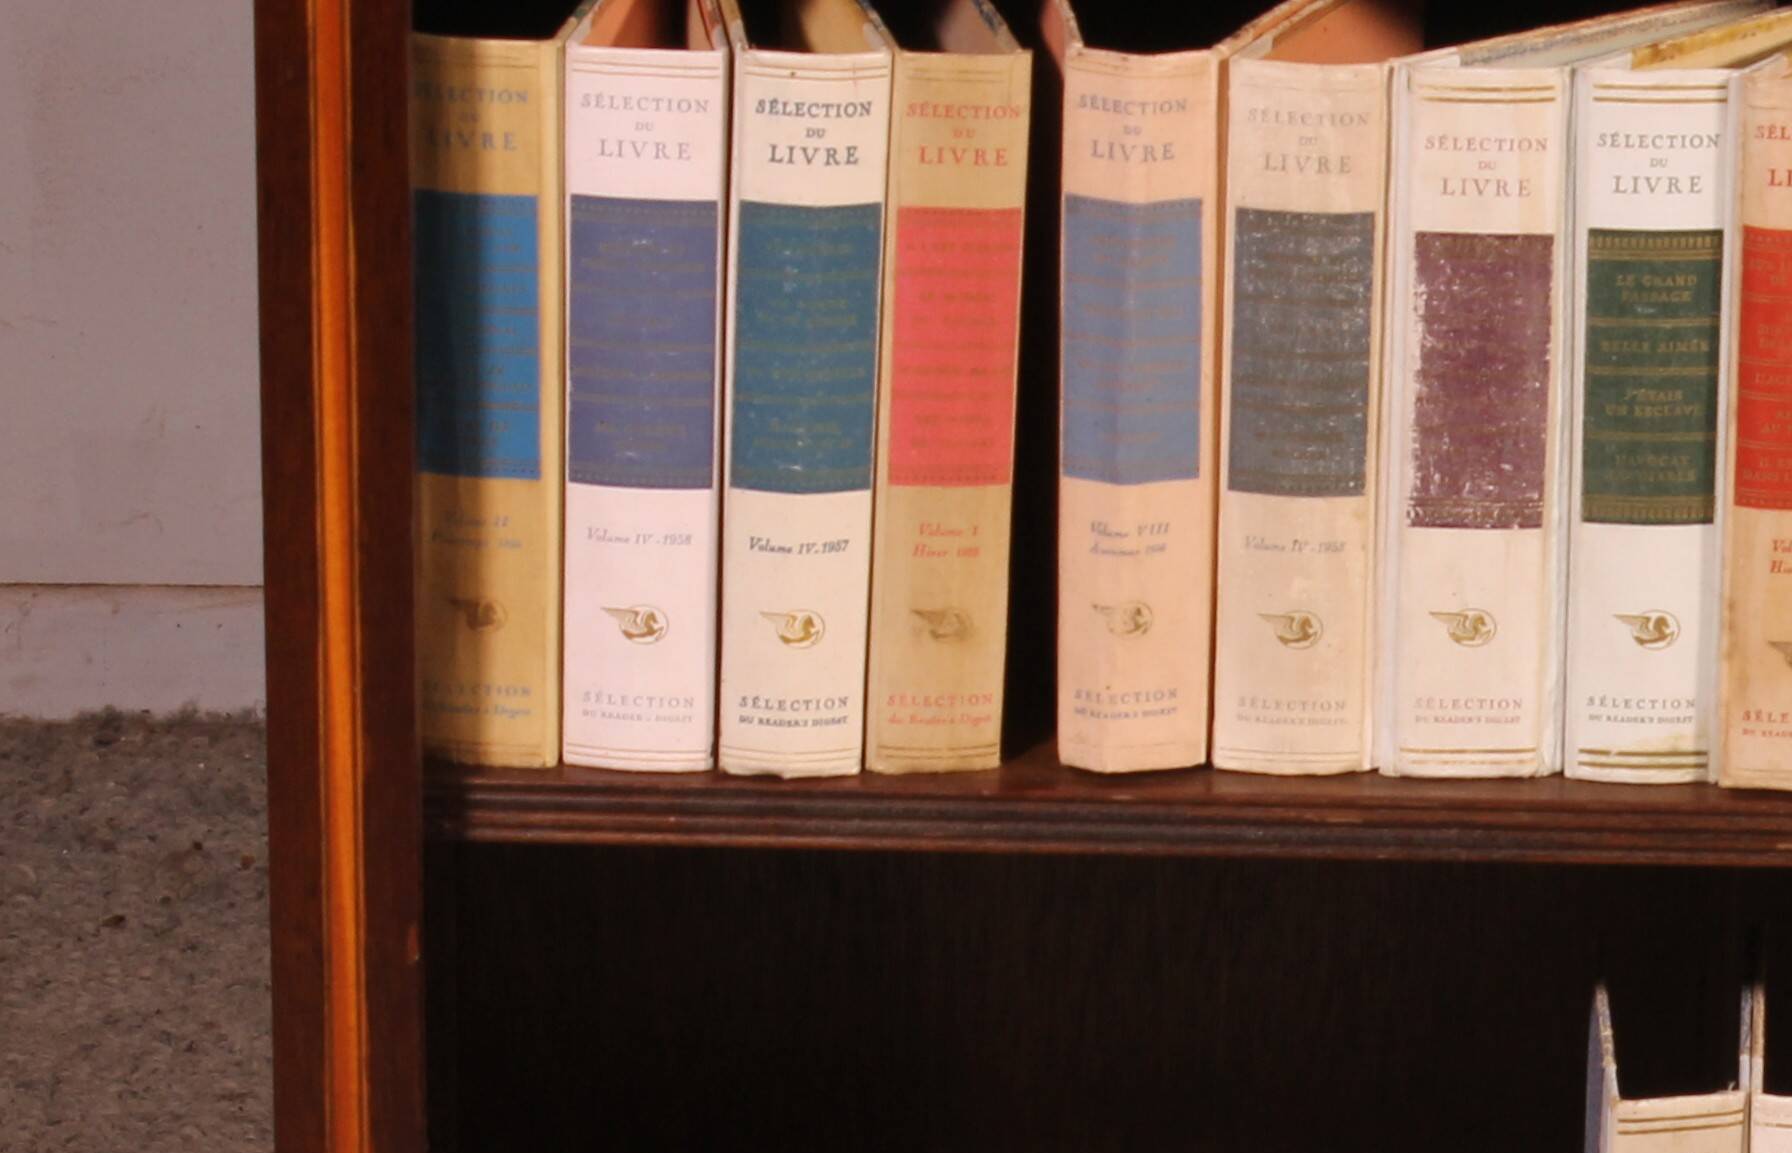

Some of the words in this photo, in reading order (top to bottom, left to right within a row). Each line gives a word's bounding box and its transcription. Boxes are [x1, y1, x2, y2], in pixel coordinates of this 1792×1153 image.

[635, 121, 654, 132] DU
[805, 127, 826, 139] DU
[954, 128, 976, 139] DU
[599, 137, 693, 162] LIVRE
[1298, 136, 1317, 146] DU
[768, 144, 860, 167] LIVRE
[918, 146, 1009, 168] LIVRE
[1090, 140, 1176, 163] LIVRE
[1264, 154, 1353, 174] LIVRE
[1478, 160, 1496, 170] DU
[1649, 158, 1668, 169] DU
[1440, 178, 1532, 198] LIVRE
[1613, 175, 1703, 195] LIVRE
[748, 536, 793, 554] Volume
